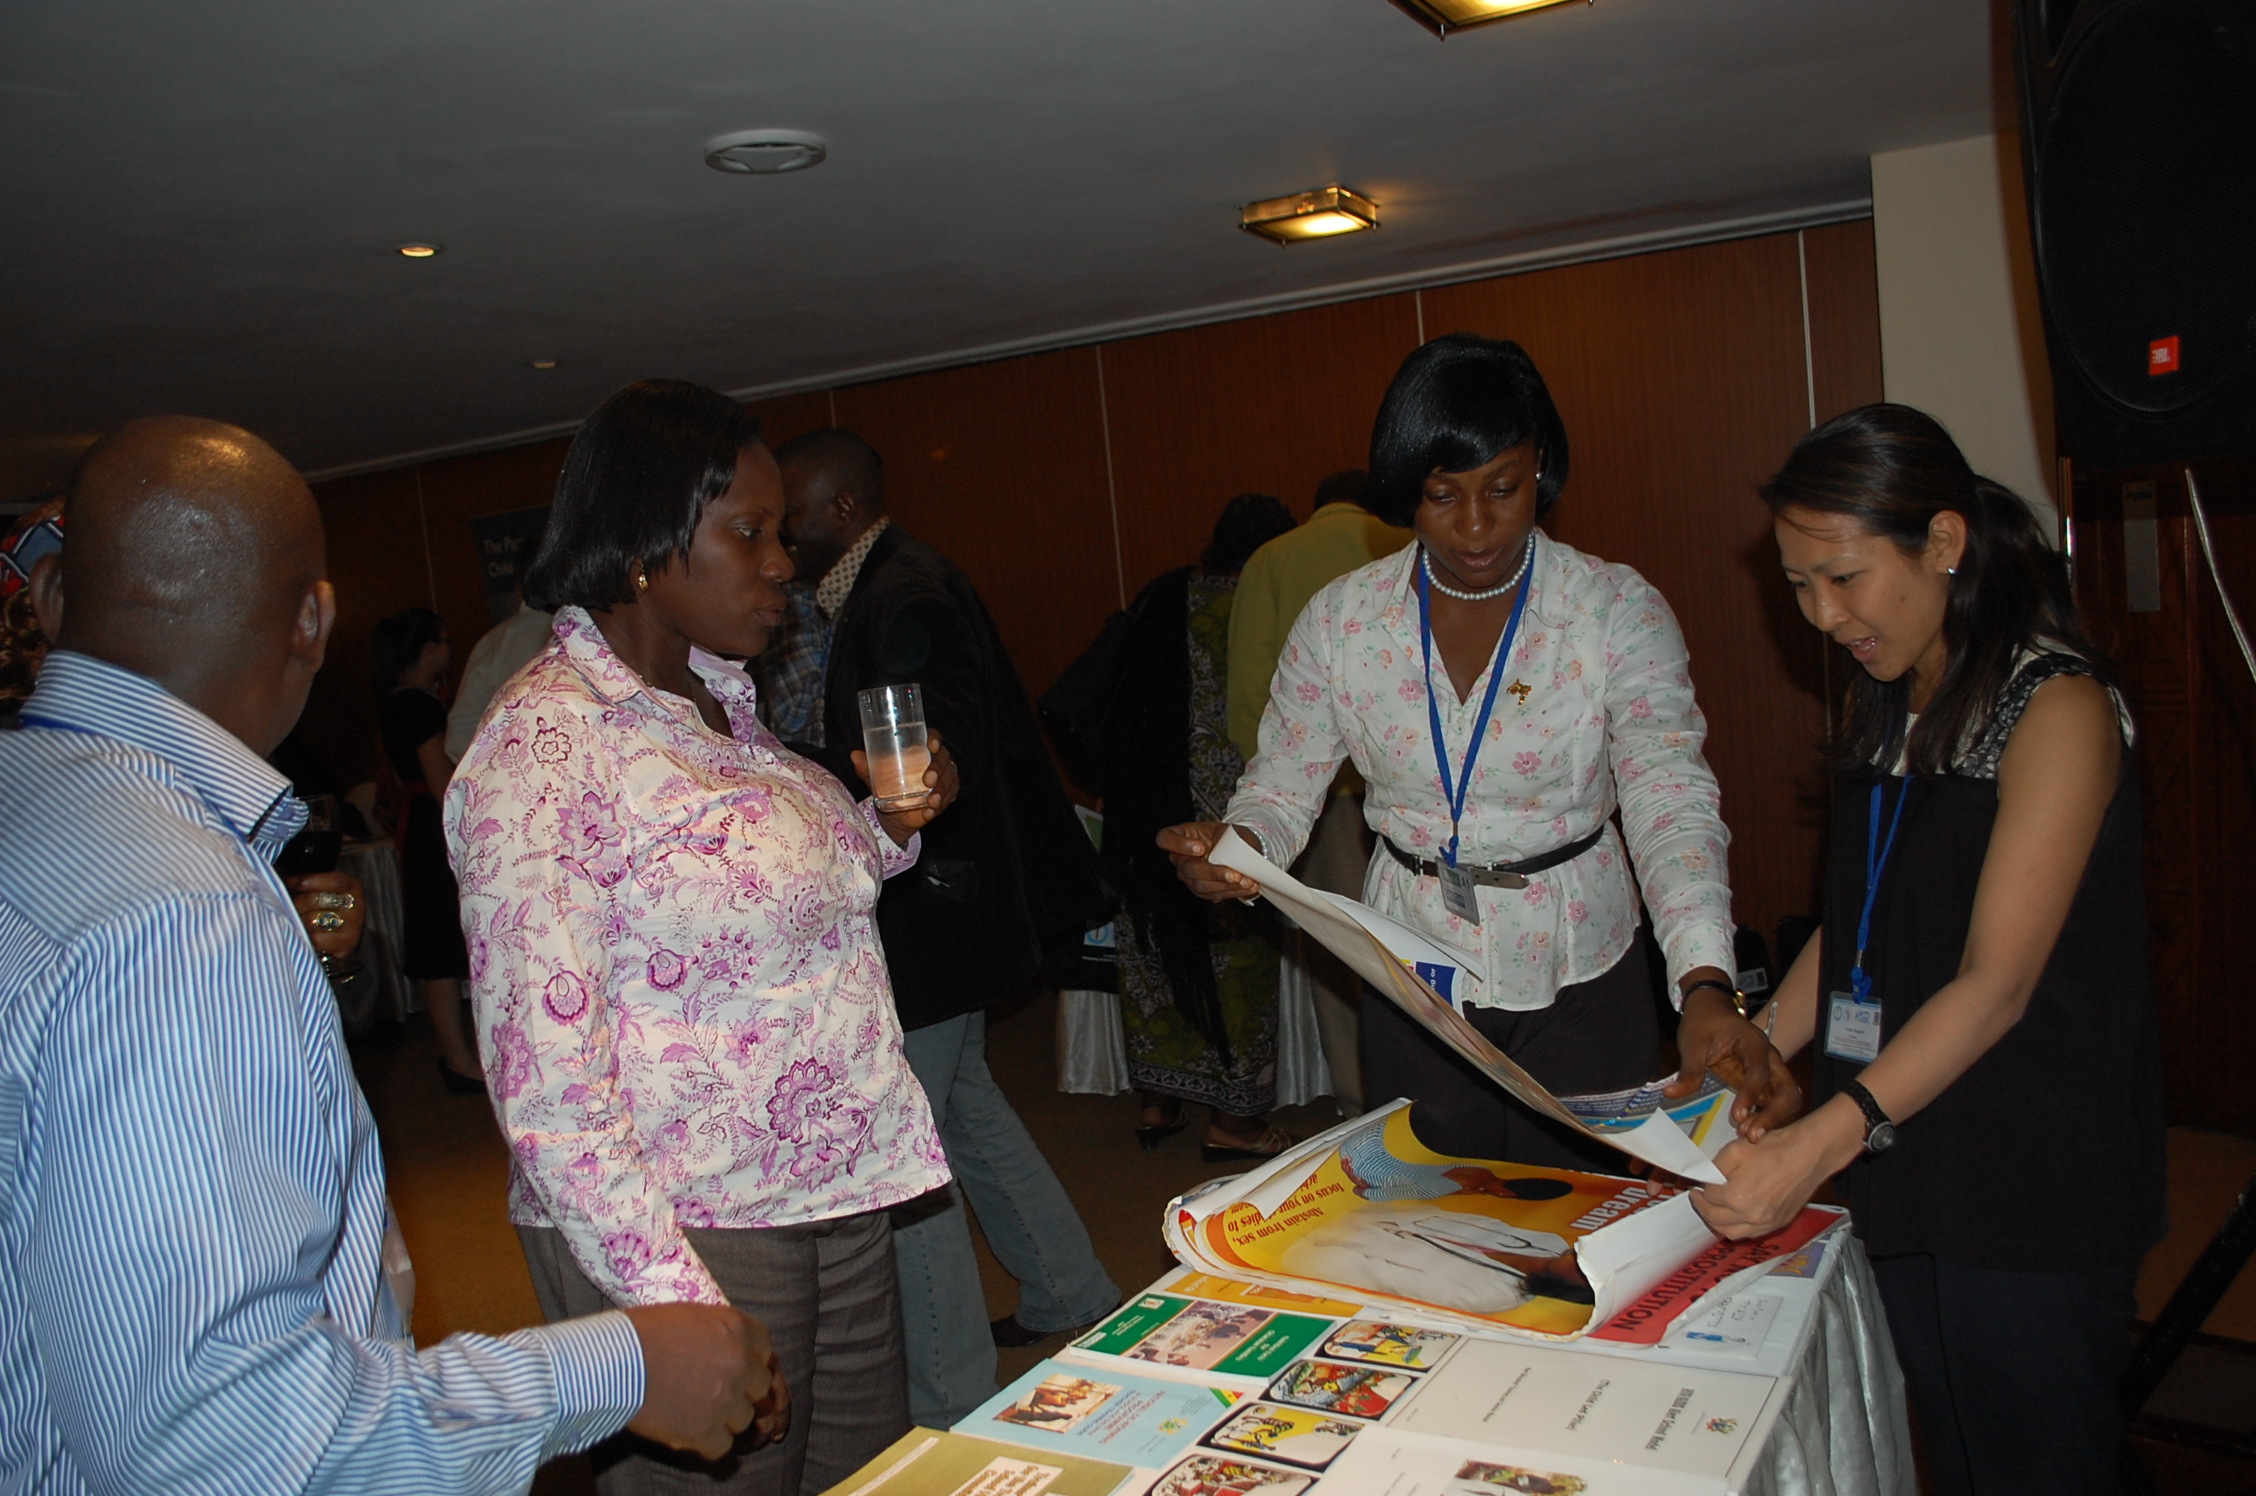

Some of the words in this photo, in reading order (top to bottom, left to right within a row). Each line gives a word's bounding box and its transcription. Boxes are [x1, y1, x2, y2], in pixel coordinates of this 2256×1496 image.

[2152, 347, 2170, 364] JBL
[1301, 1193, 1315, 1204] on
[1315, 1182, 1345, 1199] focus
[1279, 1195, 1301, 1213] your
[1570, 1186, 1649, 1231] Dream
[1283, 1206, 1324, 1226] Abstain
[1228, 1220, 1239, 1232] to
[1256, 1222, 1286, 1238] from
[1232, 1233, 1257, 1247] sex,
[1611, 1244, 1736, 1331] PROSTITUTION
